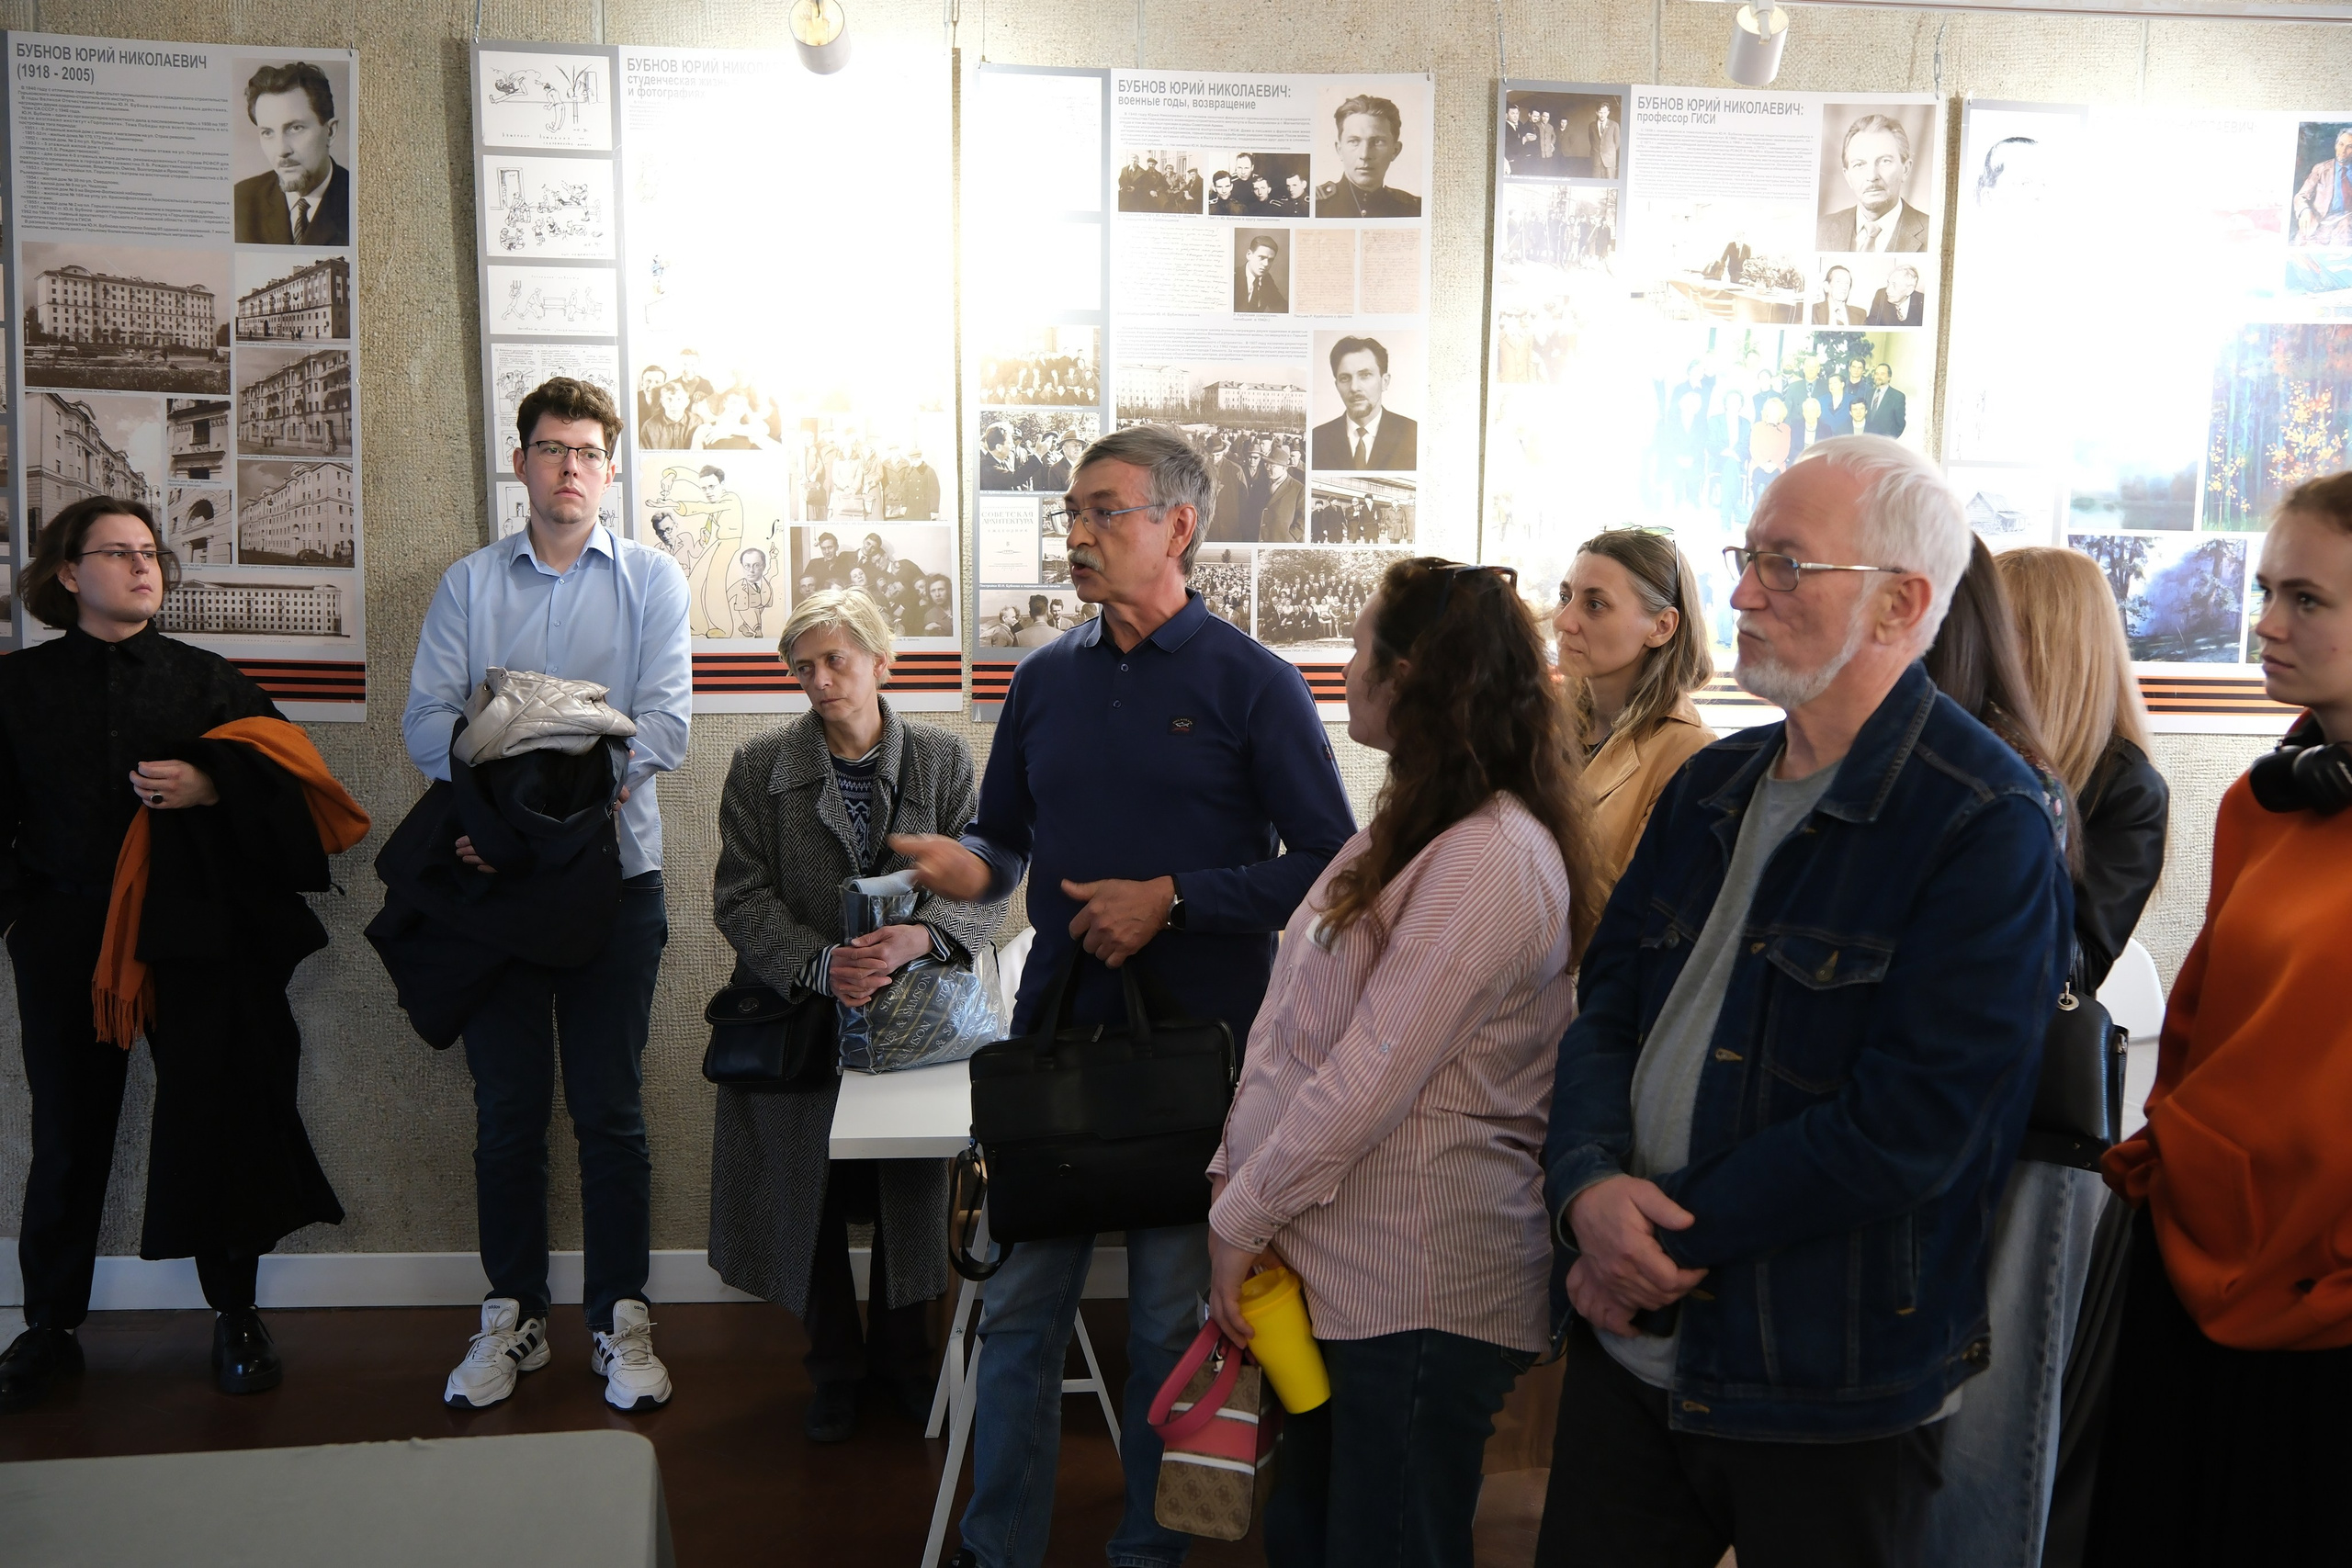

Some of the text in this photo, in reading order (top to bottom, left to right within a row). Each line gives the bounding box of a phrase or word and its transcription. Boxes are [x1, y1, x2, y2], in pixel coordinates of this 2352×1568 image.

[17, 42, 207, 69] БУБНОВ ЮРИЙ НИКОЛАЕВИЧ
[627, 58, 678, 73] БУБНОВ
[682, 57, 718, 73] ЮРИЙ
[17, 63, 51, 81] (1918
[62, 66, 95, 85] 2005)
[628, 74, 729, 88] студенческая жизнь
[628, 85, 706, 100] и фотографиях
[1118, 78, 1292, 98] БУБНОВ ЮРИЙ НИКОЛАЕВИЧ:
[1118, 96, 1257, 111] военные годы, возвращение
[1637, 96, 1804, 116] БУБНОВ ЮРИЙ НИКОЛАЕВИЧ:
[1636, 111, 1717, 126] профессор ГИСИ
[903, 973, 932, 1016] SAMSON
[899, 1021, 932, 1059] SAMSON
